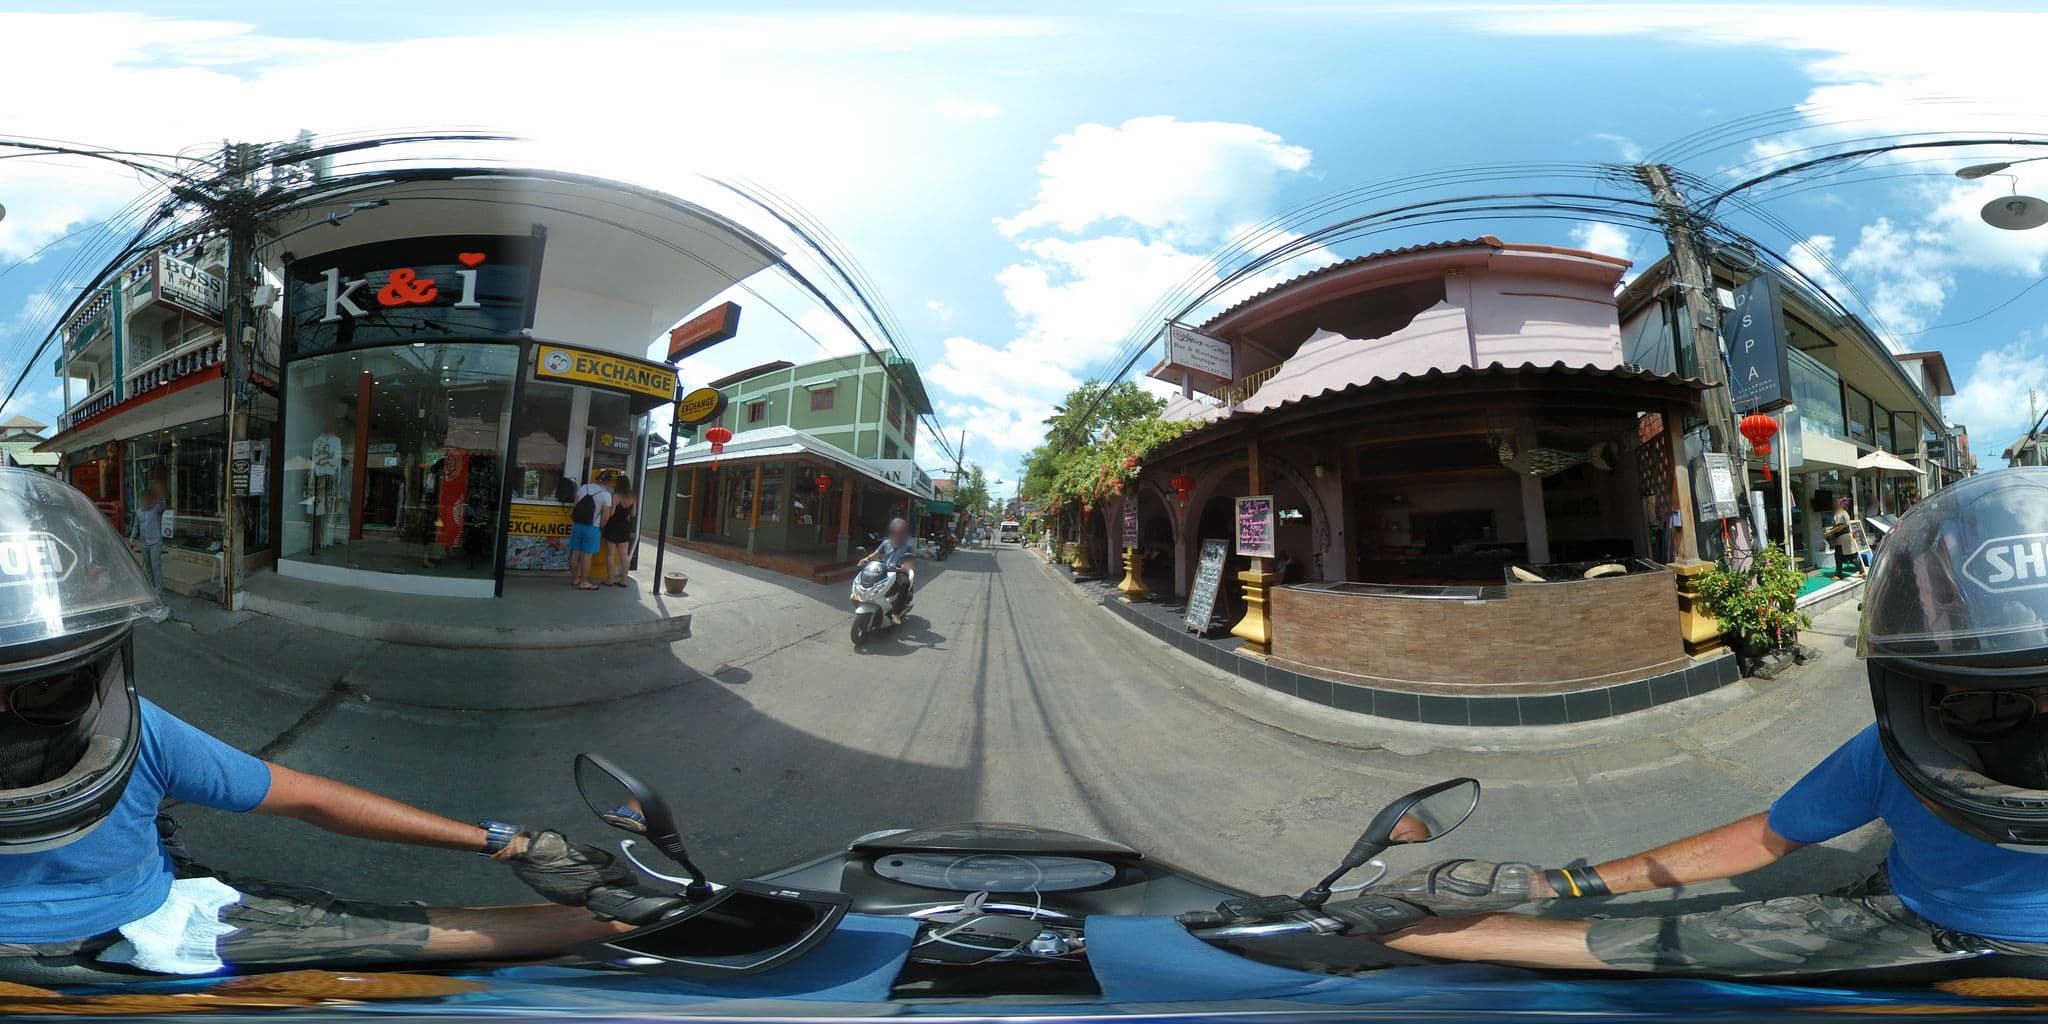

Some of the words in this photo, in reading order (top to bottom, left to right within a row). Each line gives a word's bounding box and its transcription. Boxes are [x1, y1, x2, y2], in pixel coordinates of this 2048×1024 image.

[163, 257, 221, 292] BOSS
[377, 267, 438, 307] &
[575, 357, 671, 392] EXCHANGE
[681, 396, 715, 413] EXCHANGE
[614, 441, 629, 449] atm
[509, 521, 572, 536] EXCHANGE
[1985, 542, 2048, 583] SH
